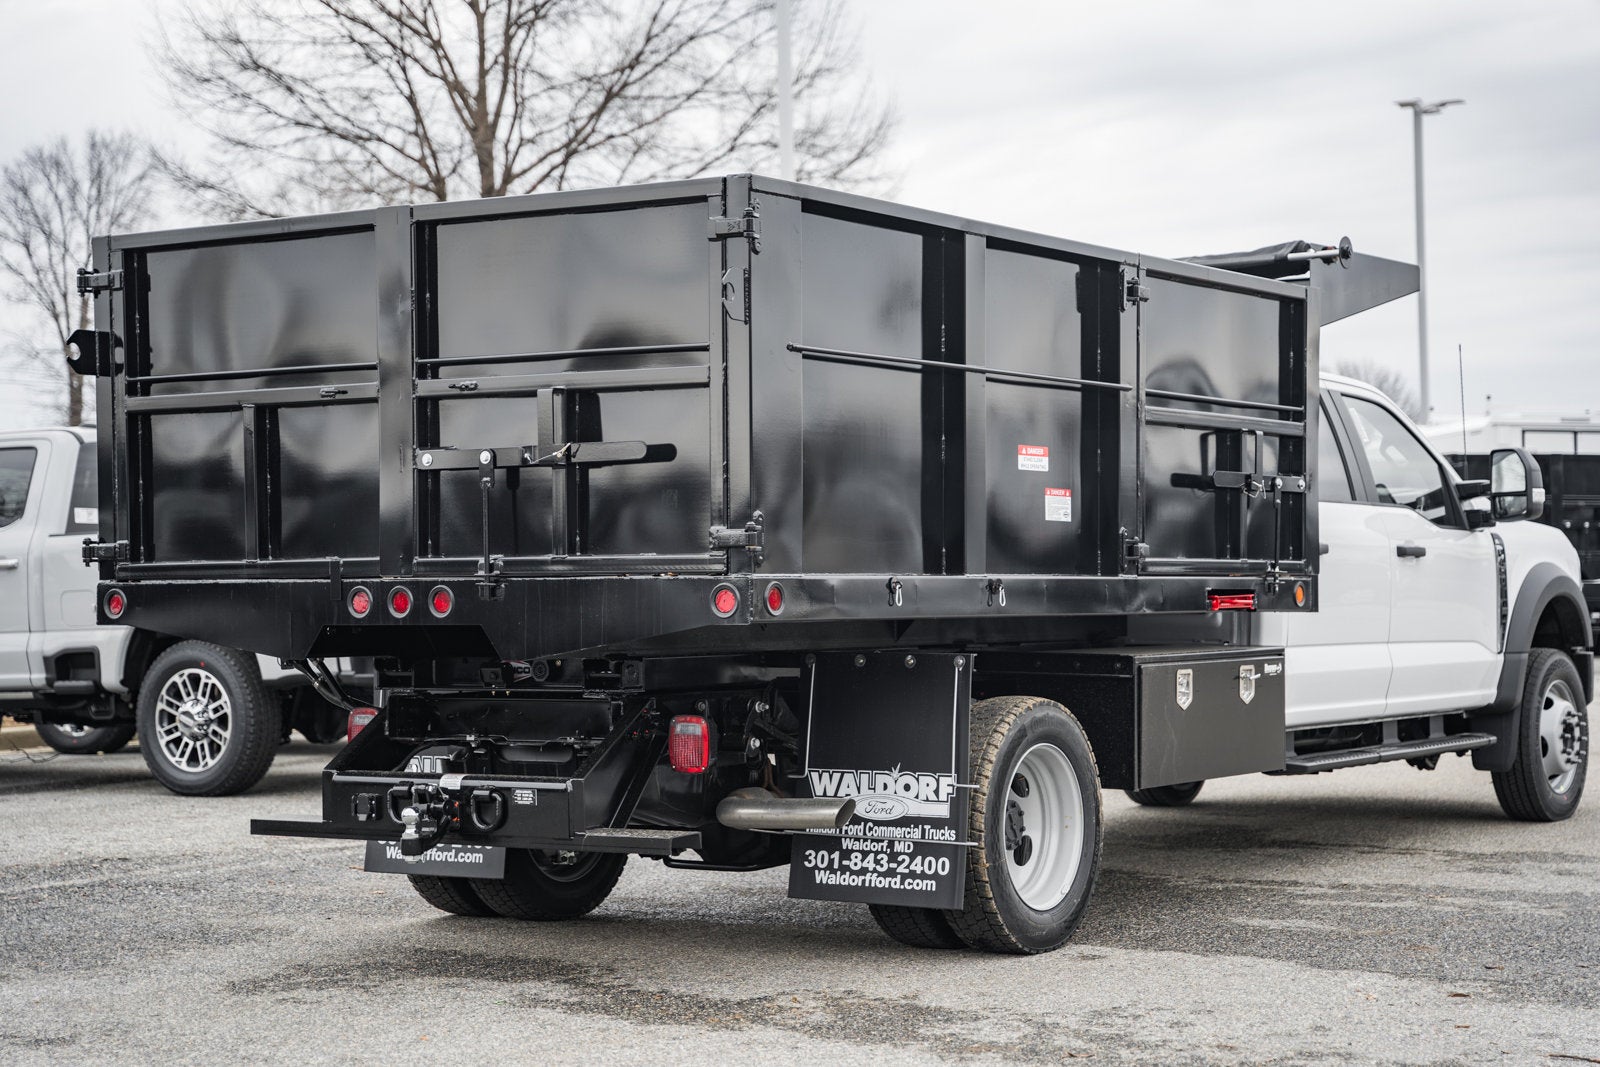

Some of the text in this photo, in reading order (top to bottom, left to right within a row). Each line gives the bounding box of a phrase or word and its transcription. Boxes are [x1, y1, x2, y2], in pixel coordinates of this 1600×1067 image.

[808, 769, 956, 802] WALDORF
[864, 800, 895, 815] Ford
[842, 822, 864, 836] Ford
[866, 822, 922, 839] Commercial
[924, 825, 956, 841] Trucks
[386, 845, 483, 864] Wafford.com
[841, 838, 914, 854] Waldorf, MD
[804, 850, 950, 876] 301-843-2400
[814, 870, 936, 892] Waldorfford.com
